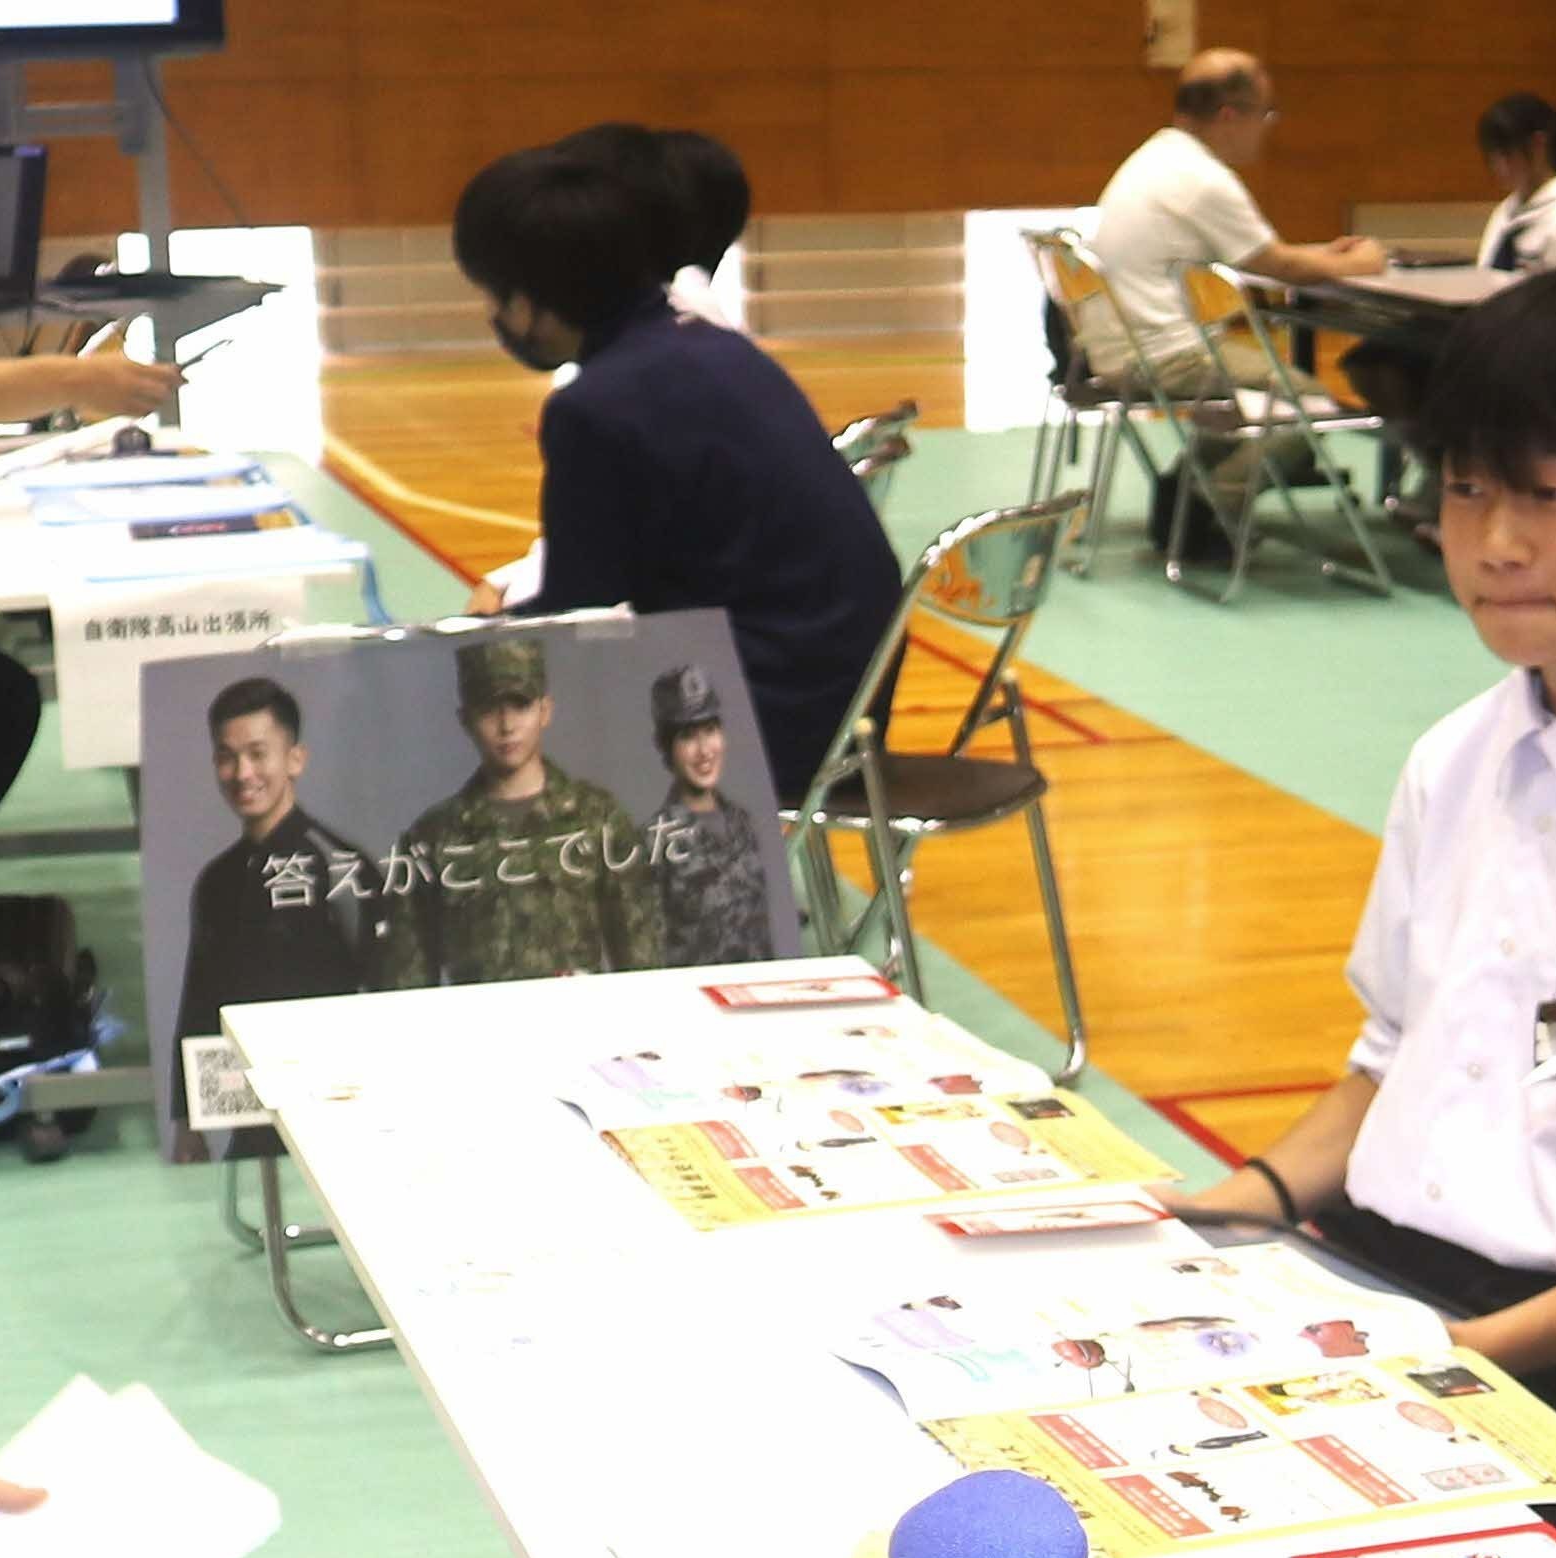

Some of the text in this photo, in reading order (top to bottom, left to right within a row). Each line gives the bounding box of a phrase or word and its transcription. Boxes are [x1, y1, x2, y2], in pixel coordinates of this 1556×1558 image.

[262, 815, 695, 909] 答えがここでした
